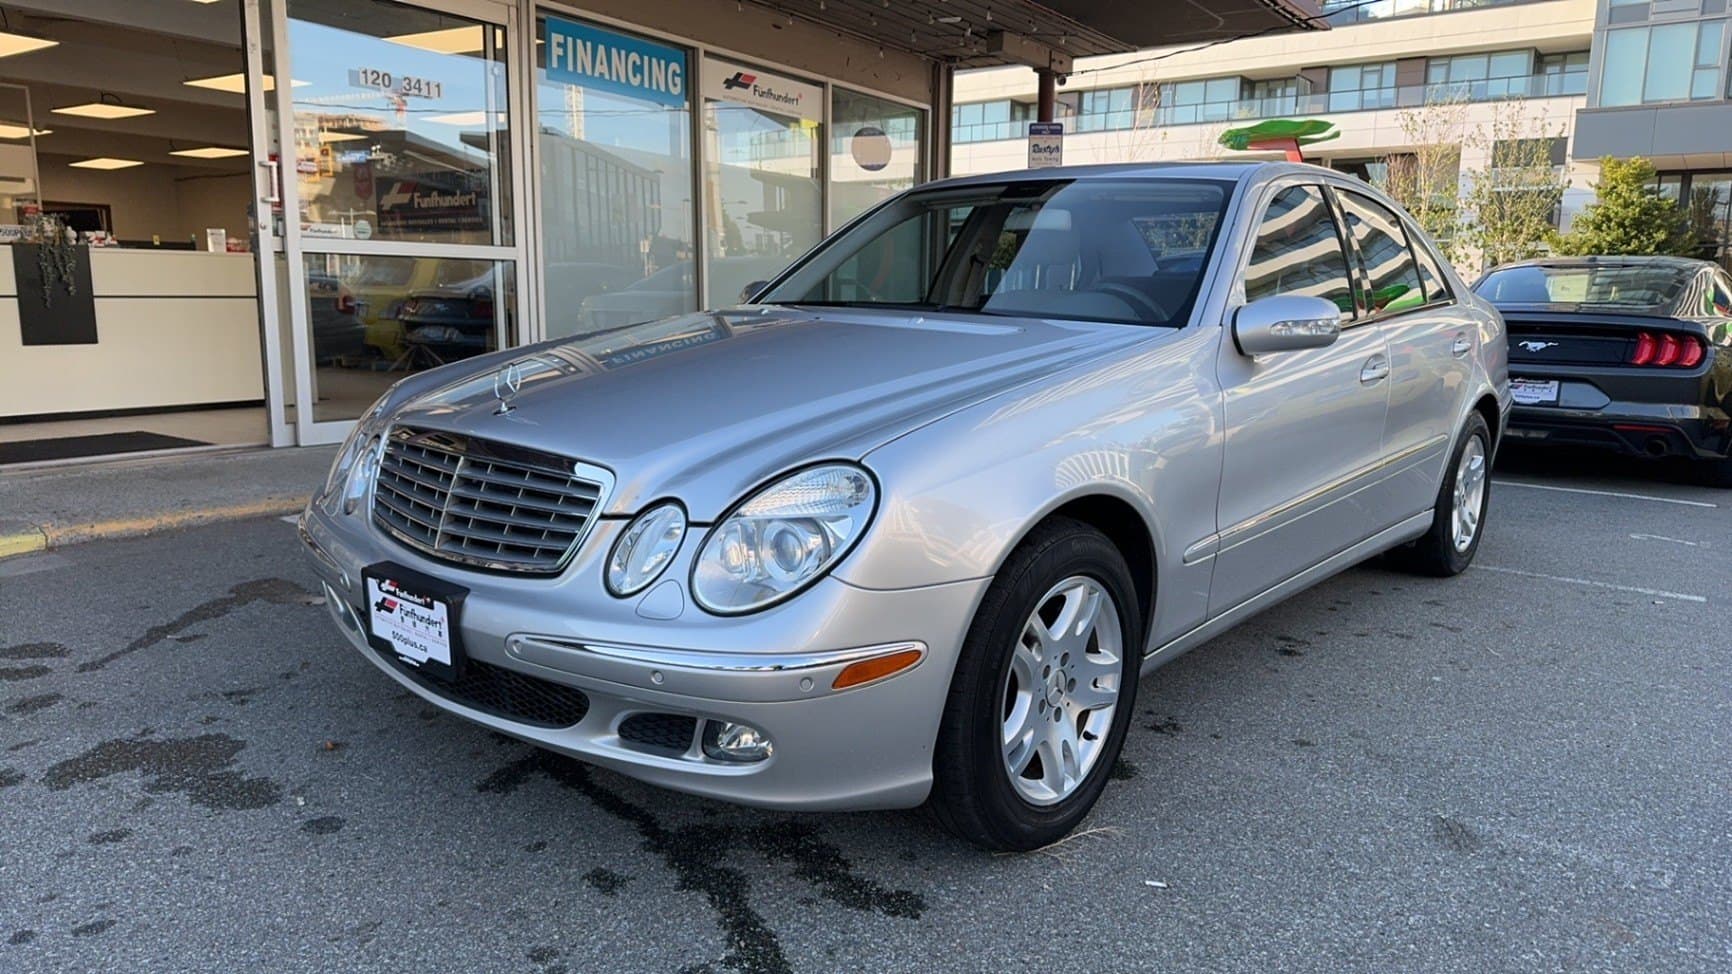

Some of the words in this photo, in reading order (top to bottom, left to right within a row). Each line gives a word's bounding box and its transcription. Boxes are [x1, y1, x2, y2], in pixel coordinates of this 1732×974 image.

[361, 68, 392, 89] 120
[403, 76, 442, 98] 3411
[550, 32, 682, 95] FINANCING
